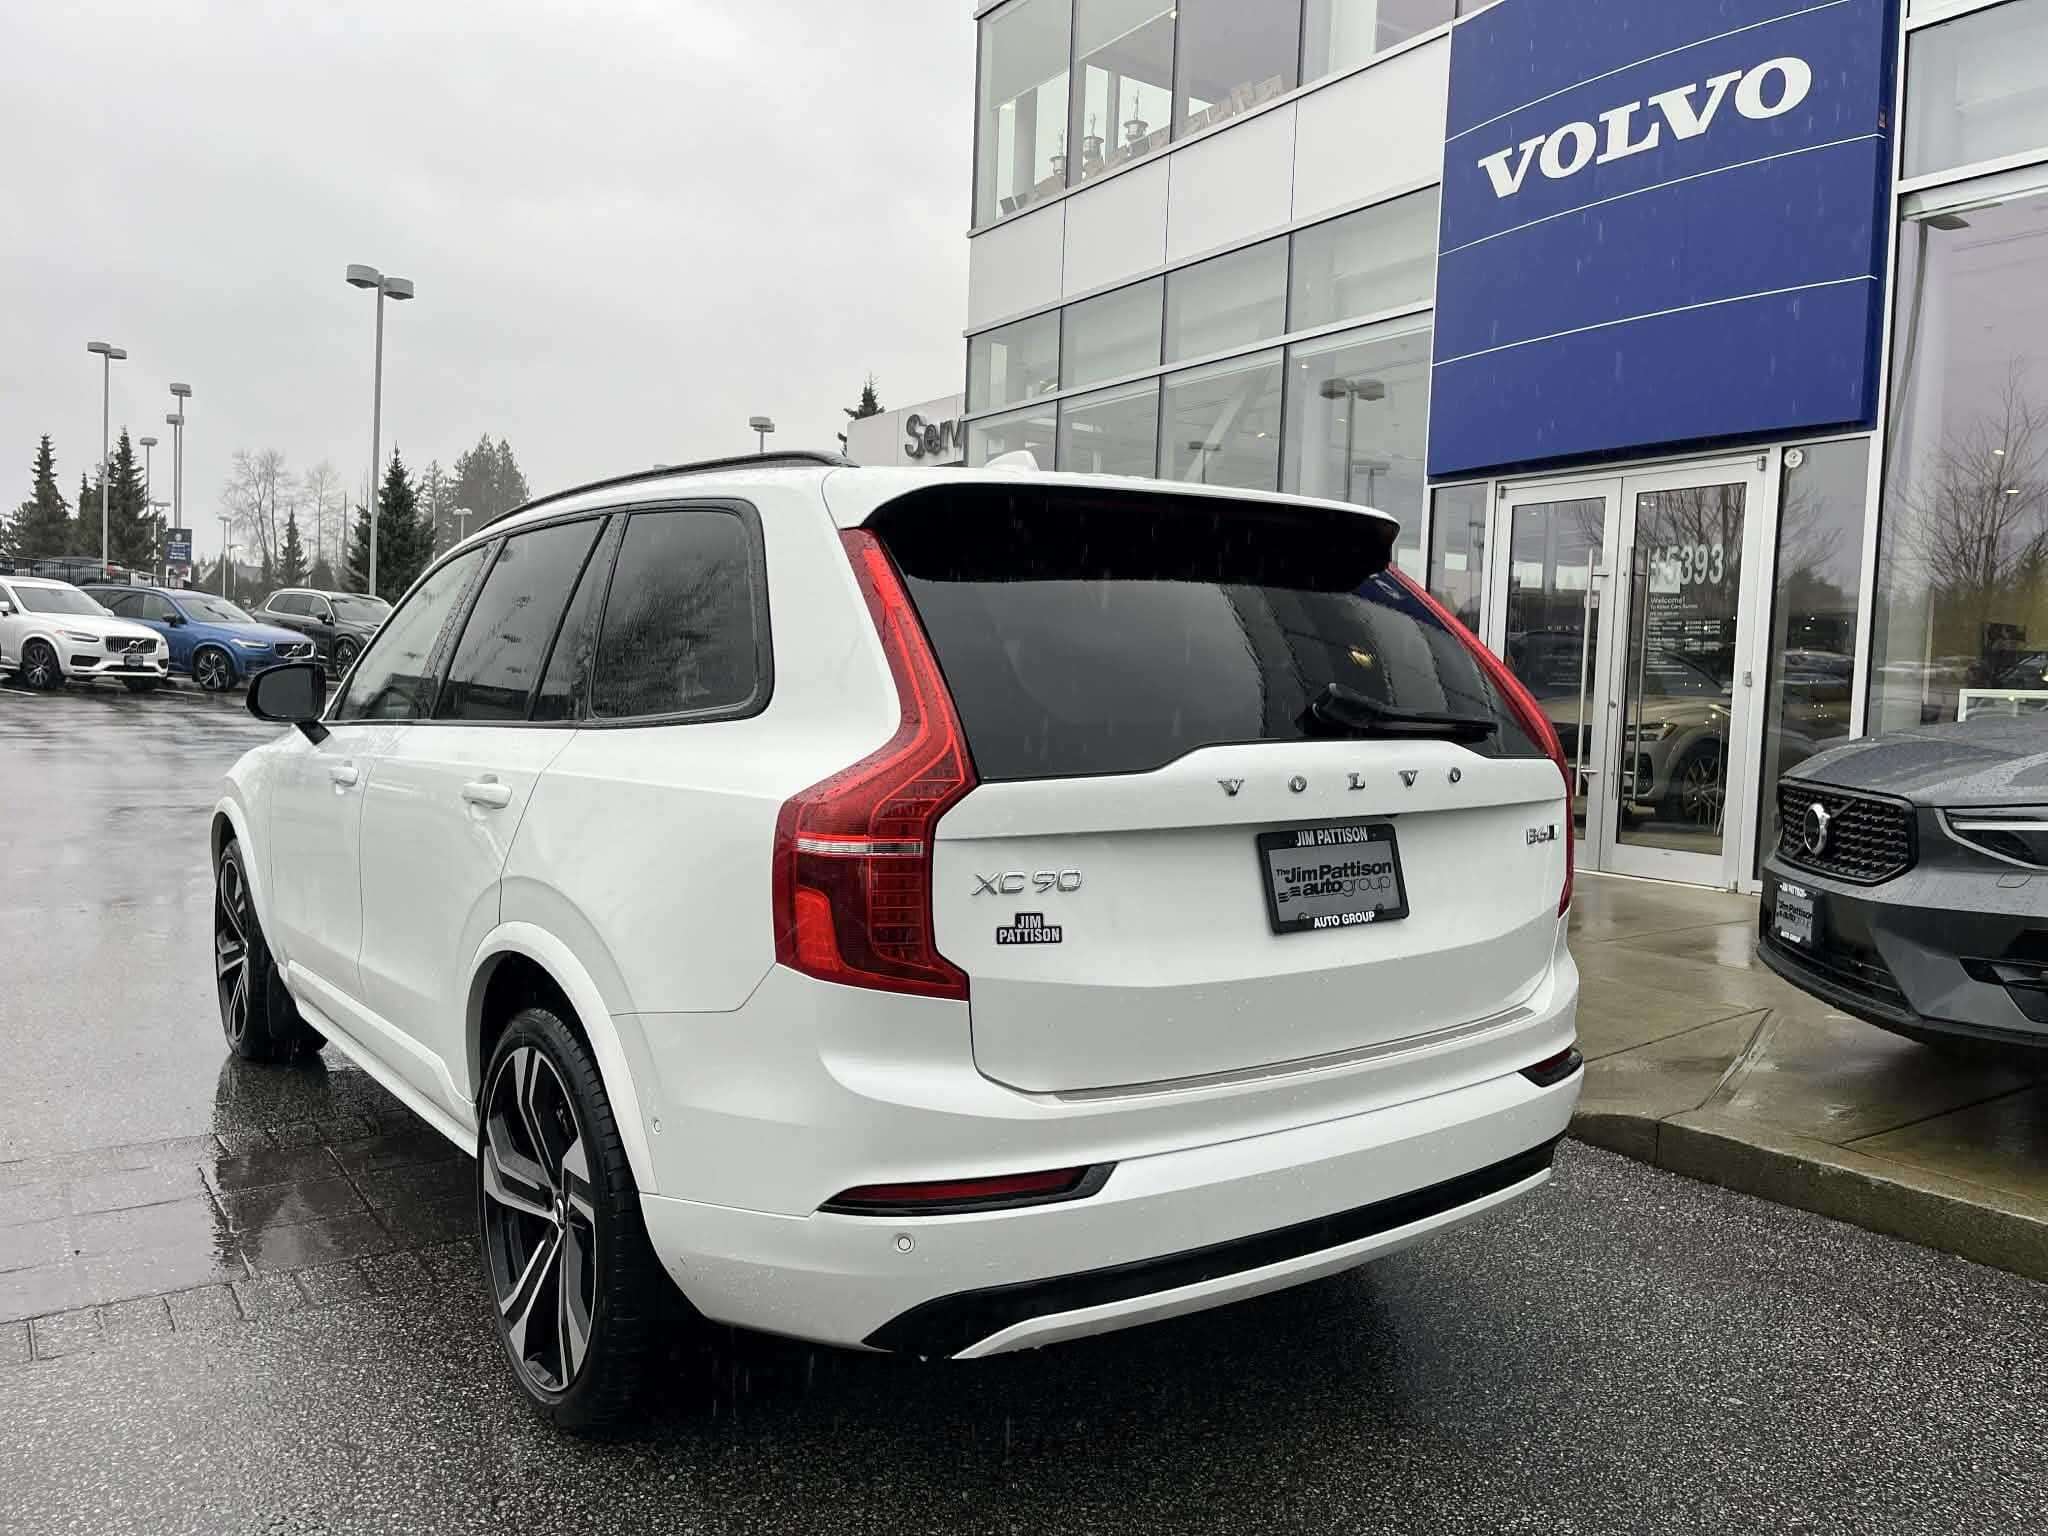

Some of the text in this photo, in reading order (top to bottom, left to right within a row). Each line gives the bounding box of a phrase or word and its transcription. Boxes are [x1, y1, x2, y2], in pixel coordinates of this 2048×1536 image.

[1477, 56, 1812, 199] VOLVO
[904, 414, 961, 460] Serv
[1217, 767, 1462, 796] VOLVO
[1297, 826, 1368, 847] JIM PATTISON
[1018, 915, 1041, 928] JIM
[1313, 911, 1375, 928] AUTO GROUP
[998, 928, 1060, 943] PATTISON
